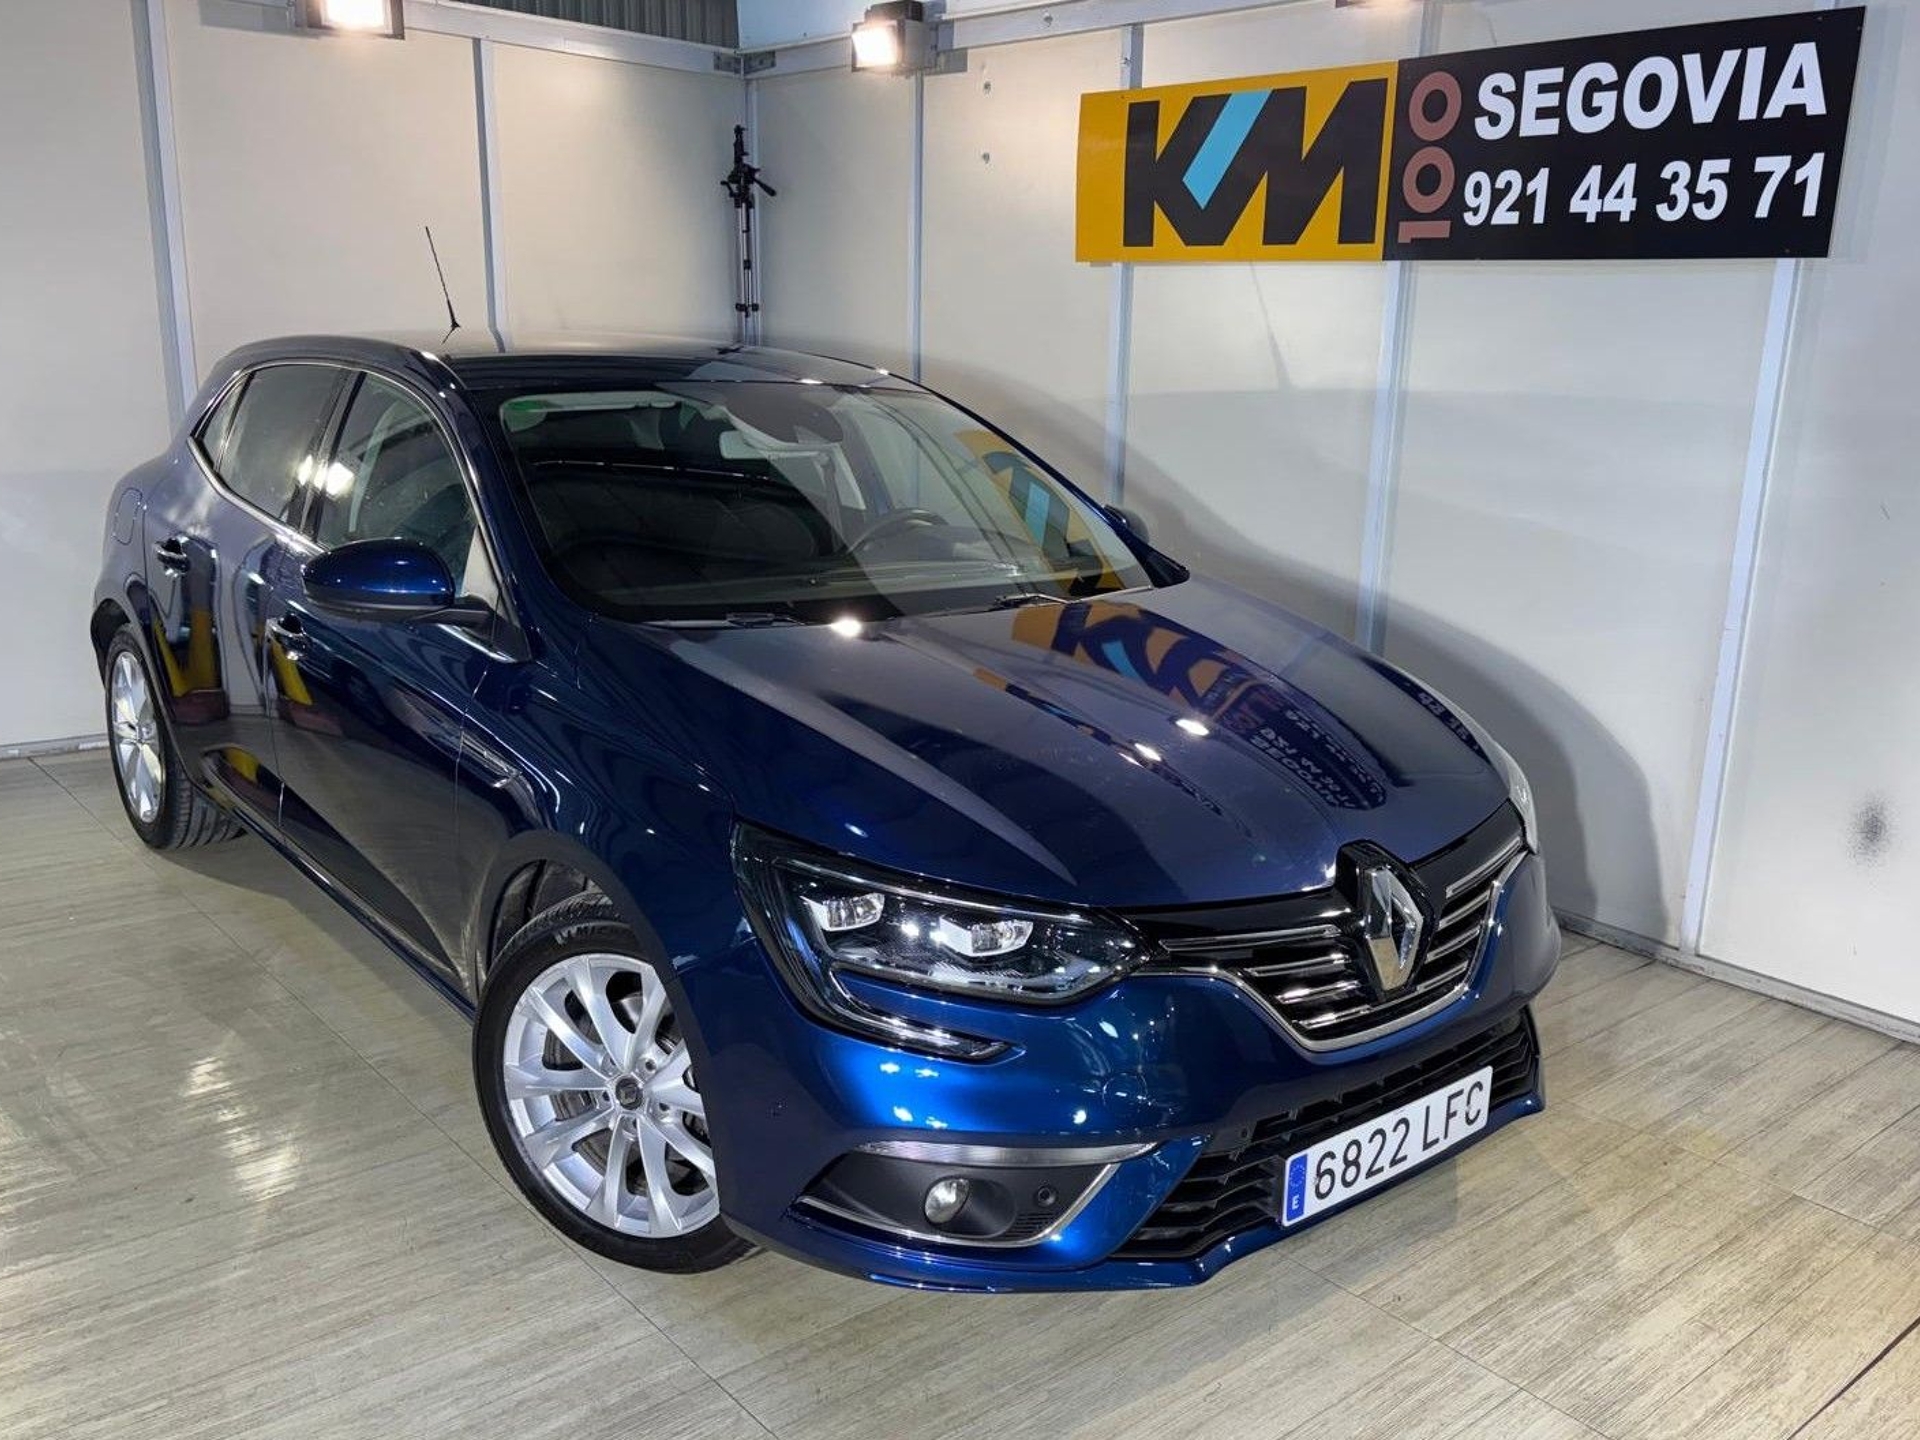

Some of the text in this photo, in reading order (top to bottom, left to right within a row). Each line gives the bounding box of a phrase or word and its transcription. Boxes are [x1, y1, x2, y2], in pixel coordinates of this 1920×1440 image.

[1474, 41, 1828, 141] SEGOVIA
[1123, 77, 1388, 248] KM
[1463, 152, 1826, 227] 921 44 35 71
[1314, 1080, 1484, 1200] 6822 LFC
[1291, 1194, 1300, 1210] E
